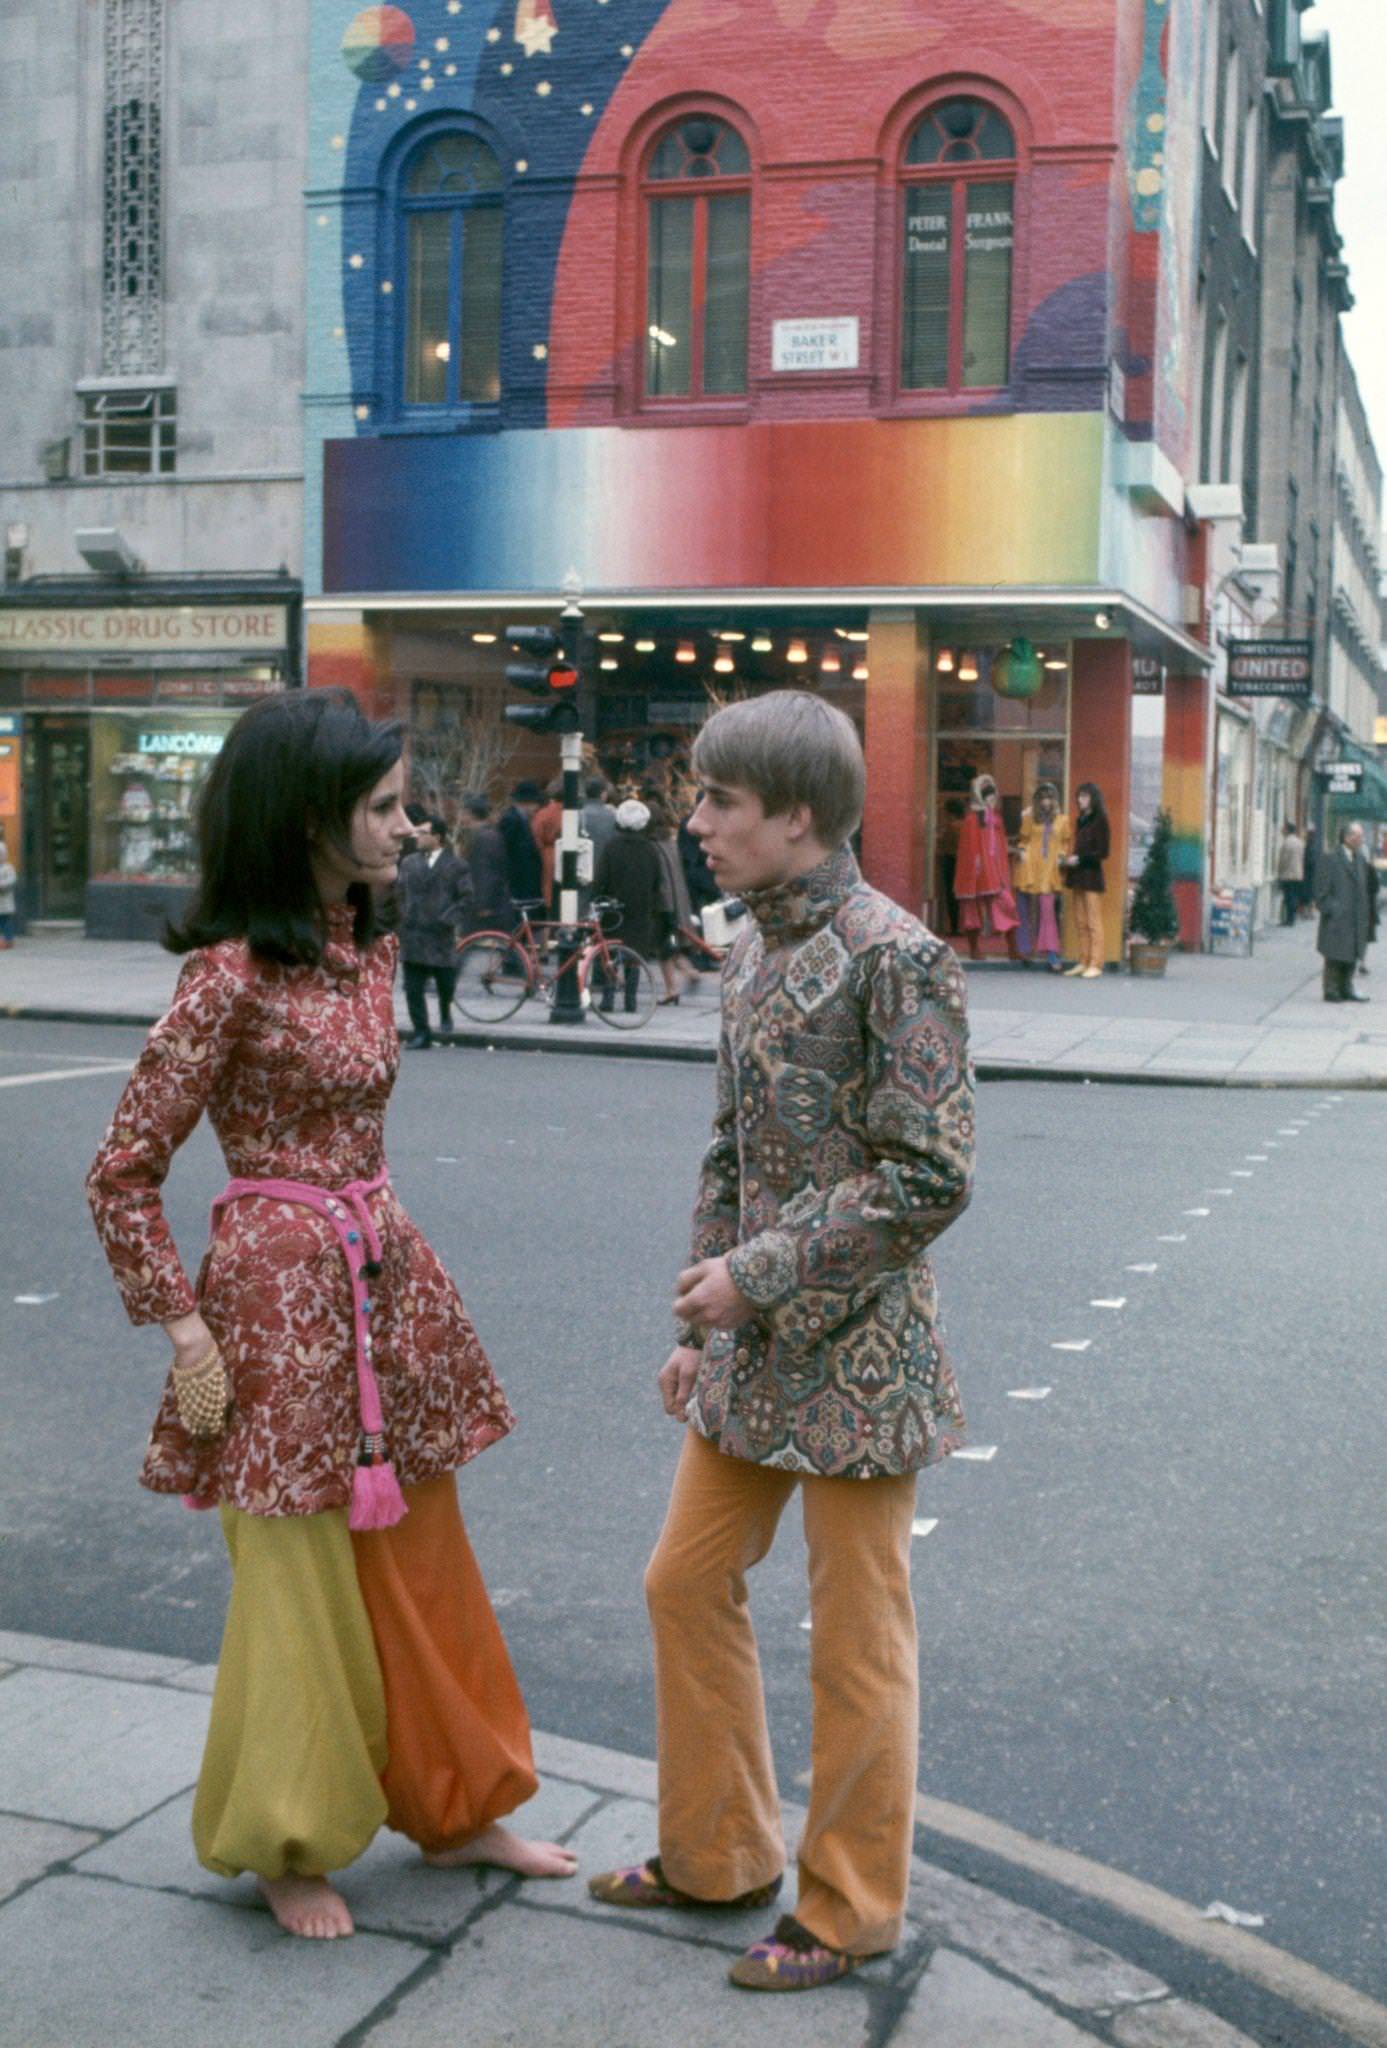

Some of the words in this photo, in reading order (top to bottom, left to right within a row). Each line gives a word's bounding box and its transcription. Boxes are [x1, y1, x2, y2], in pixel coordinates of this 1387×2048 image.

[908, 215, 947, 231] PETER
[966, 212, 1012, 229] FRANK
[791, 333, 838, 348] BAKER
[781, 350, 825, 364] STREET
[104, 614, 181, 639] DRUG
[191, 613, 276, 638] STORE
[1232, 658, 1307, 678] UNITED
